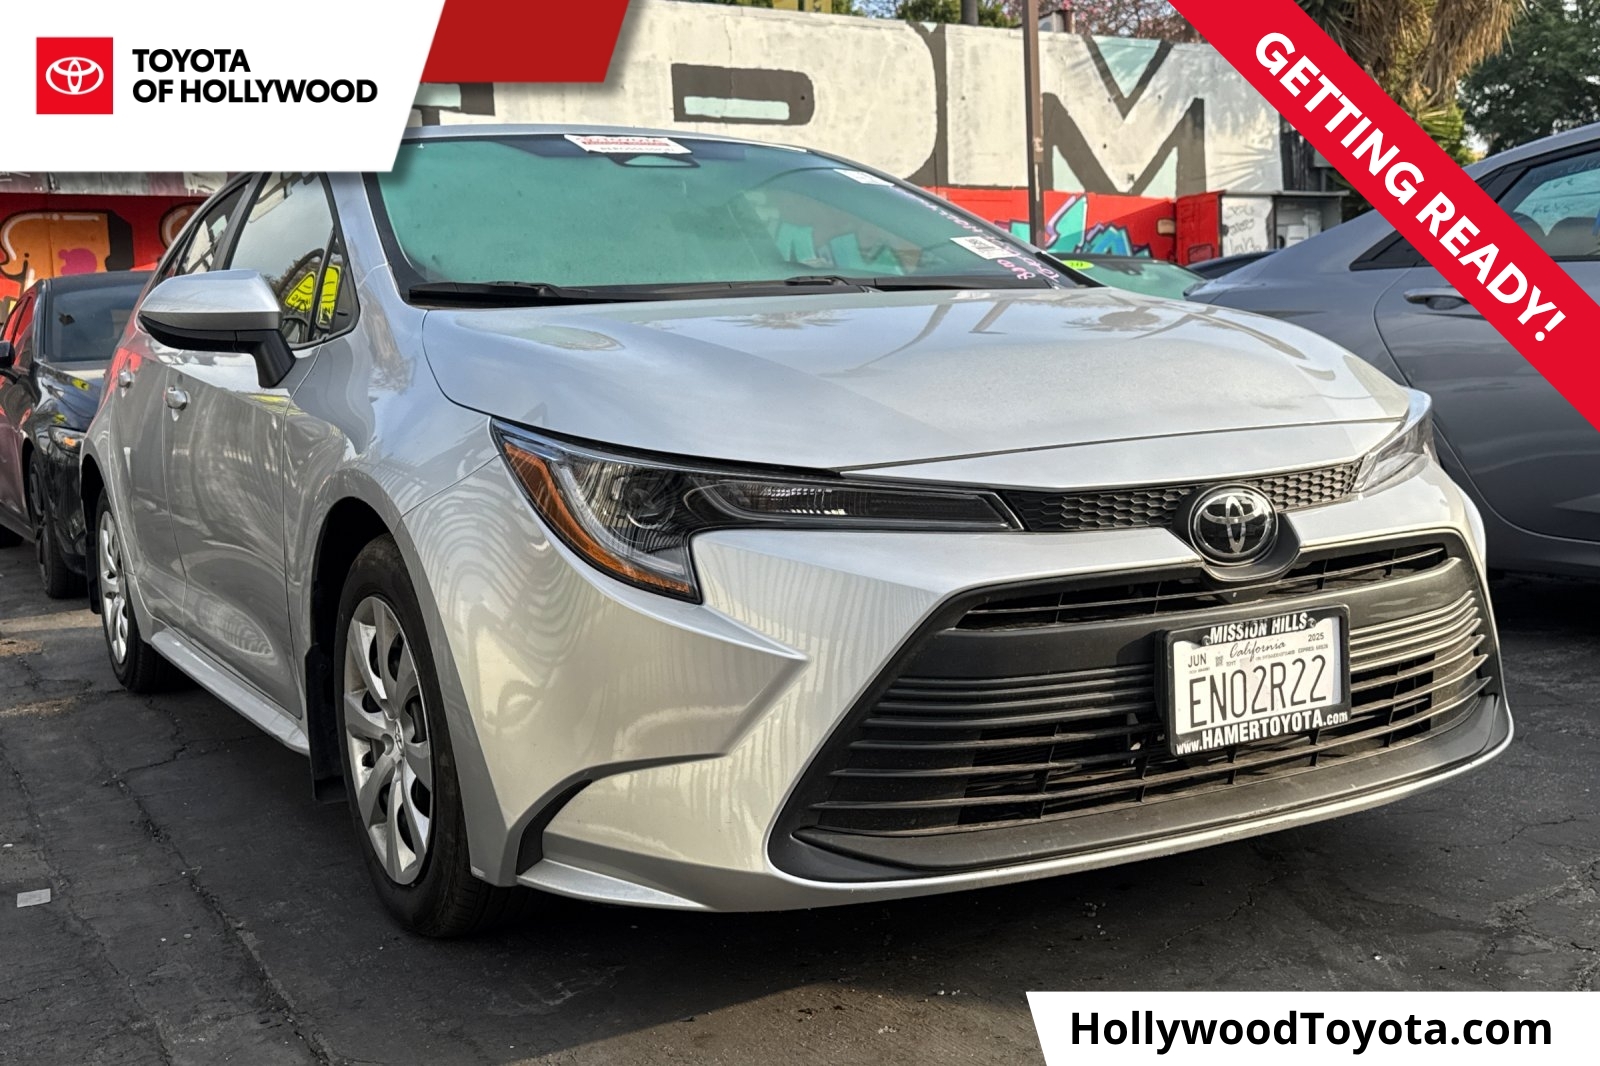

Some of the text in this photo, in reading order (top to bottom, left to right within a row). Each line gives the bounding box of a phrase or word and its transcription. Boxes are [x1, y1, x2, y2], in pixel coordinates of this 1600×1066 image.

[1209, 612, 1309, 645] MISSION HILLS
[1307, 632, 1325, 643] 2025
[1187, 653, 1207, 668] JUN
[1230, 639, 1287, 662] California
[1175, 709, 1349, 755] www.HAMERTOYOTA.com
